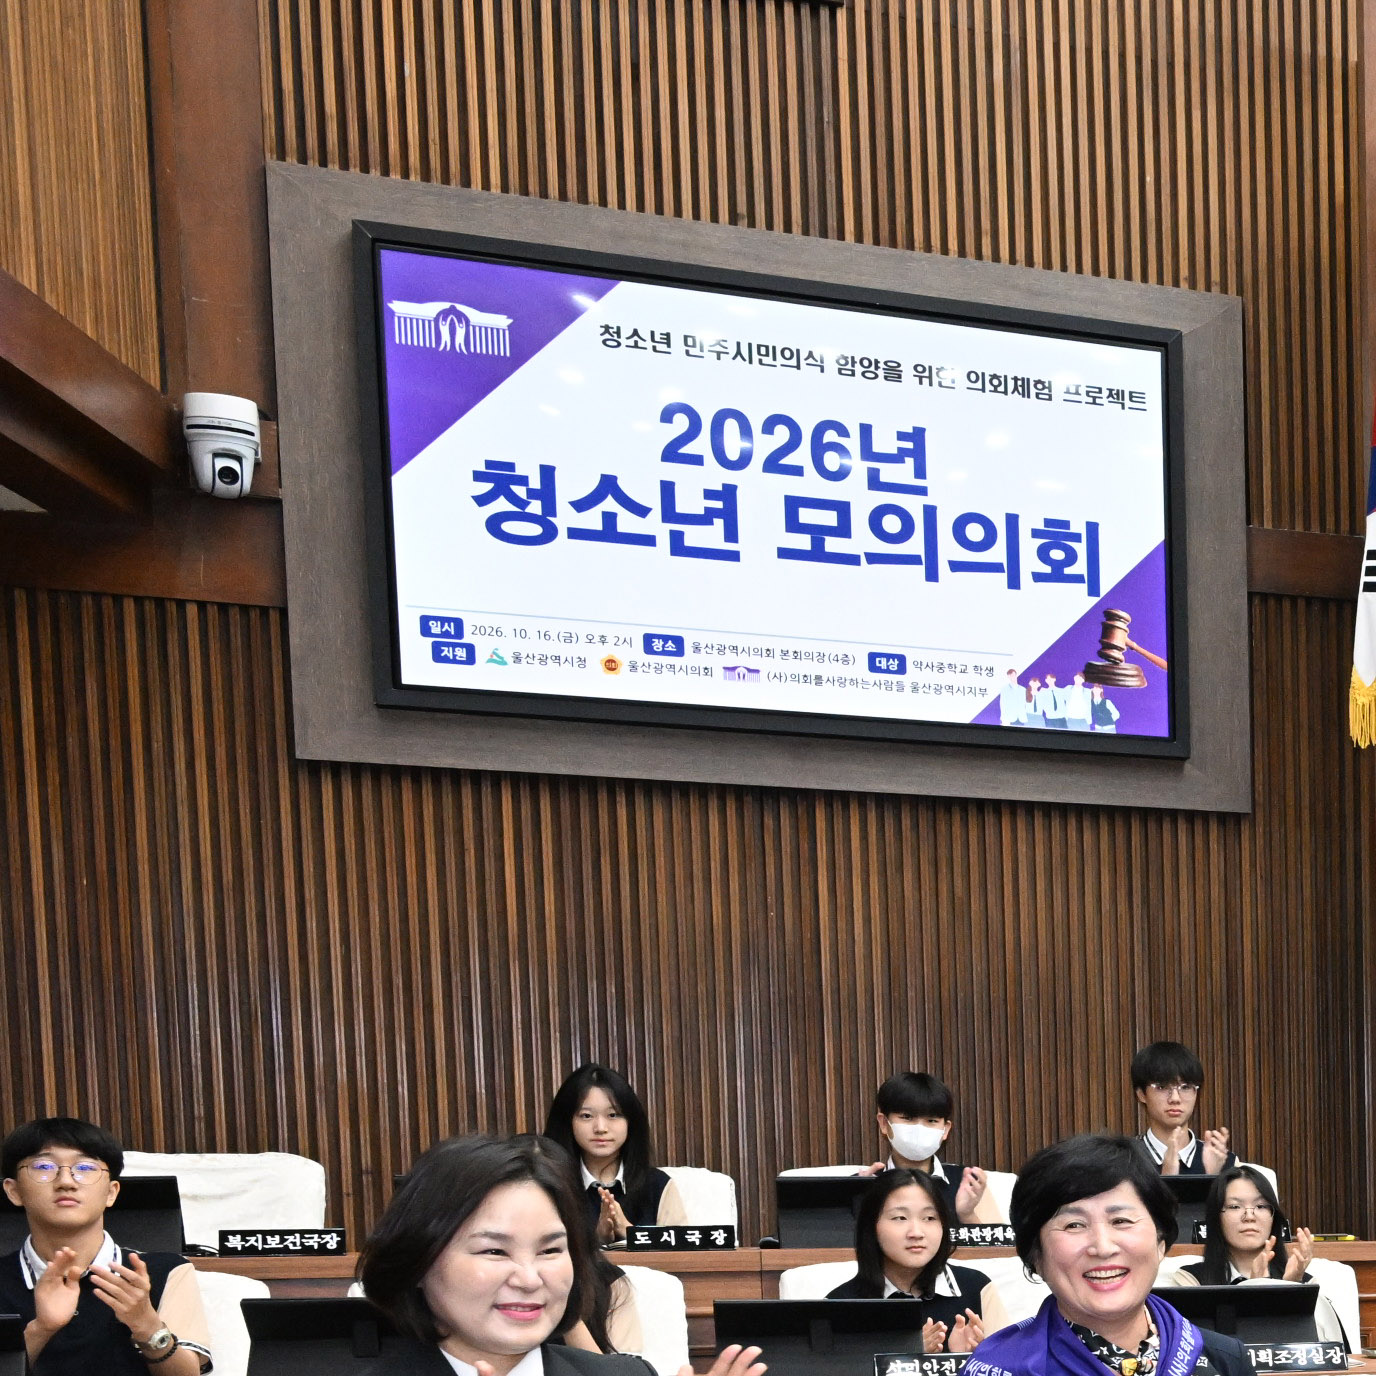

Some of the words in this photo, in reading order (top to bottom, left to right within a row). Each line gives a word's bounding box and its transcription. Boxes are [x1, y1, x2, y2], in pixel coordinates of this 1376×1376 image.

[599, 323, 672, 354] 청소년
[683, 334, 825, 373] 민주시민의식
[835, 353, 903, 383] 함양을
[966, 369, 1053, 402] 의회체험
[1062, 383, 1148, 412] 프로젝트
[659, 401, 929, 497] 2026년
[470, 458, 741, 563] 청소년
[776, 493, 1100, 598] 모의의회
[428, 619, 455, 636] 일시
[470, 623, 507, 638] 2026.
[512, 627, 531, 640] 10.
[584, 633, 610, 646] 오후
[613, 635, 633, 648] 2시
[651, 637, 678, 652] 장소
[690, 641, 775, 659] 울산광역시의회
[779, 648, 856, 666] 본회의장(4층)
[875, 656, 900, 671] 대상
[912, 658, 969, 675] 약사중학교
[972, 664, 995, 678] 학생
[440, 645, 467, 661] 지원
[510, 650, 588, 669] 울산광역시청
[627, 660, 713, 678] 울산광역시의회
[910, 681, 990, 698] 울산광역시지부
[223, 1232, 341, 1251] 복지보건국장
[633, 1229, 728, 1247] 도시국장
